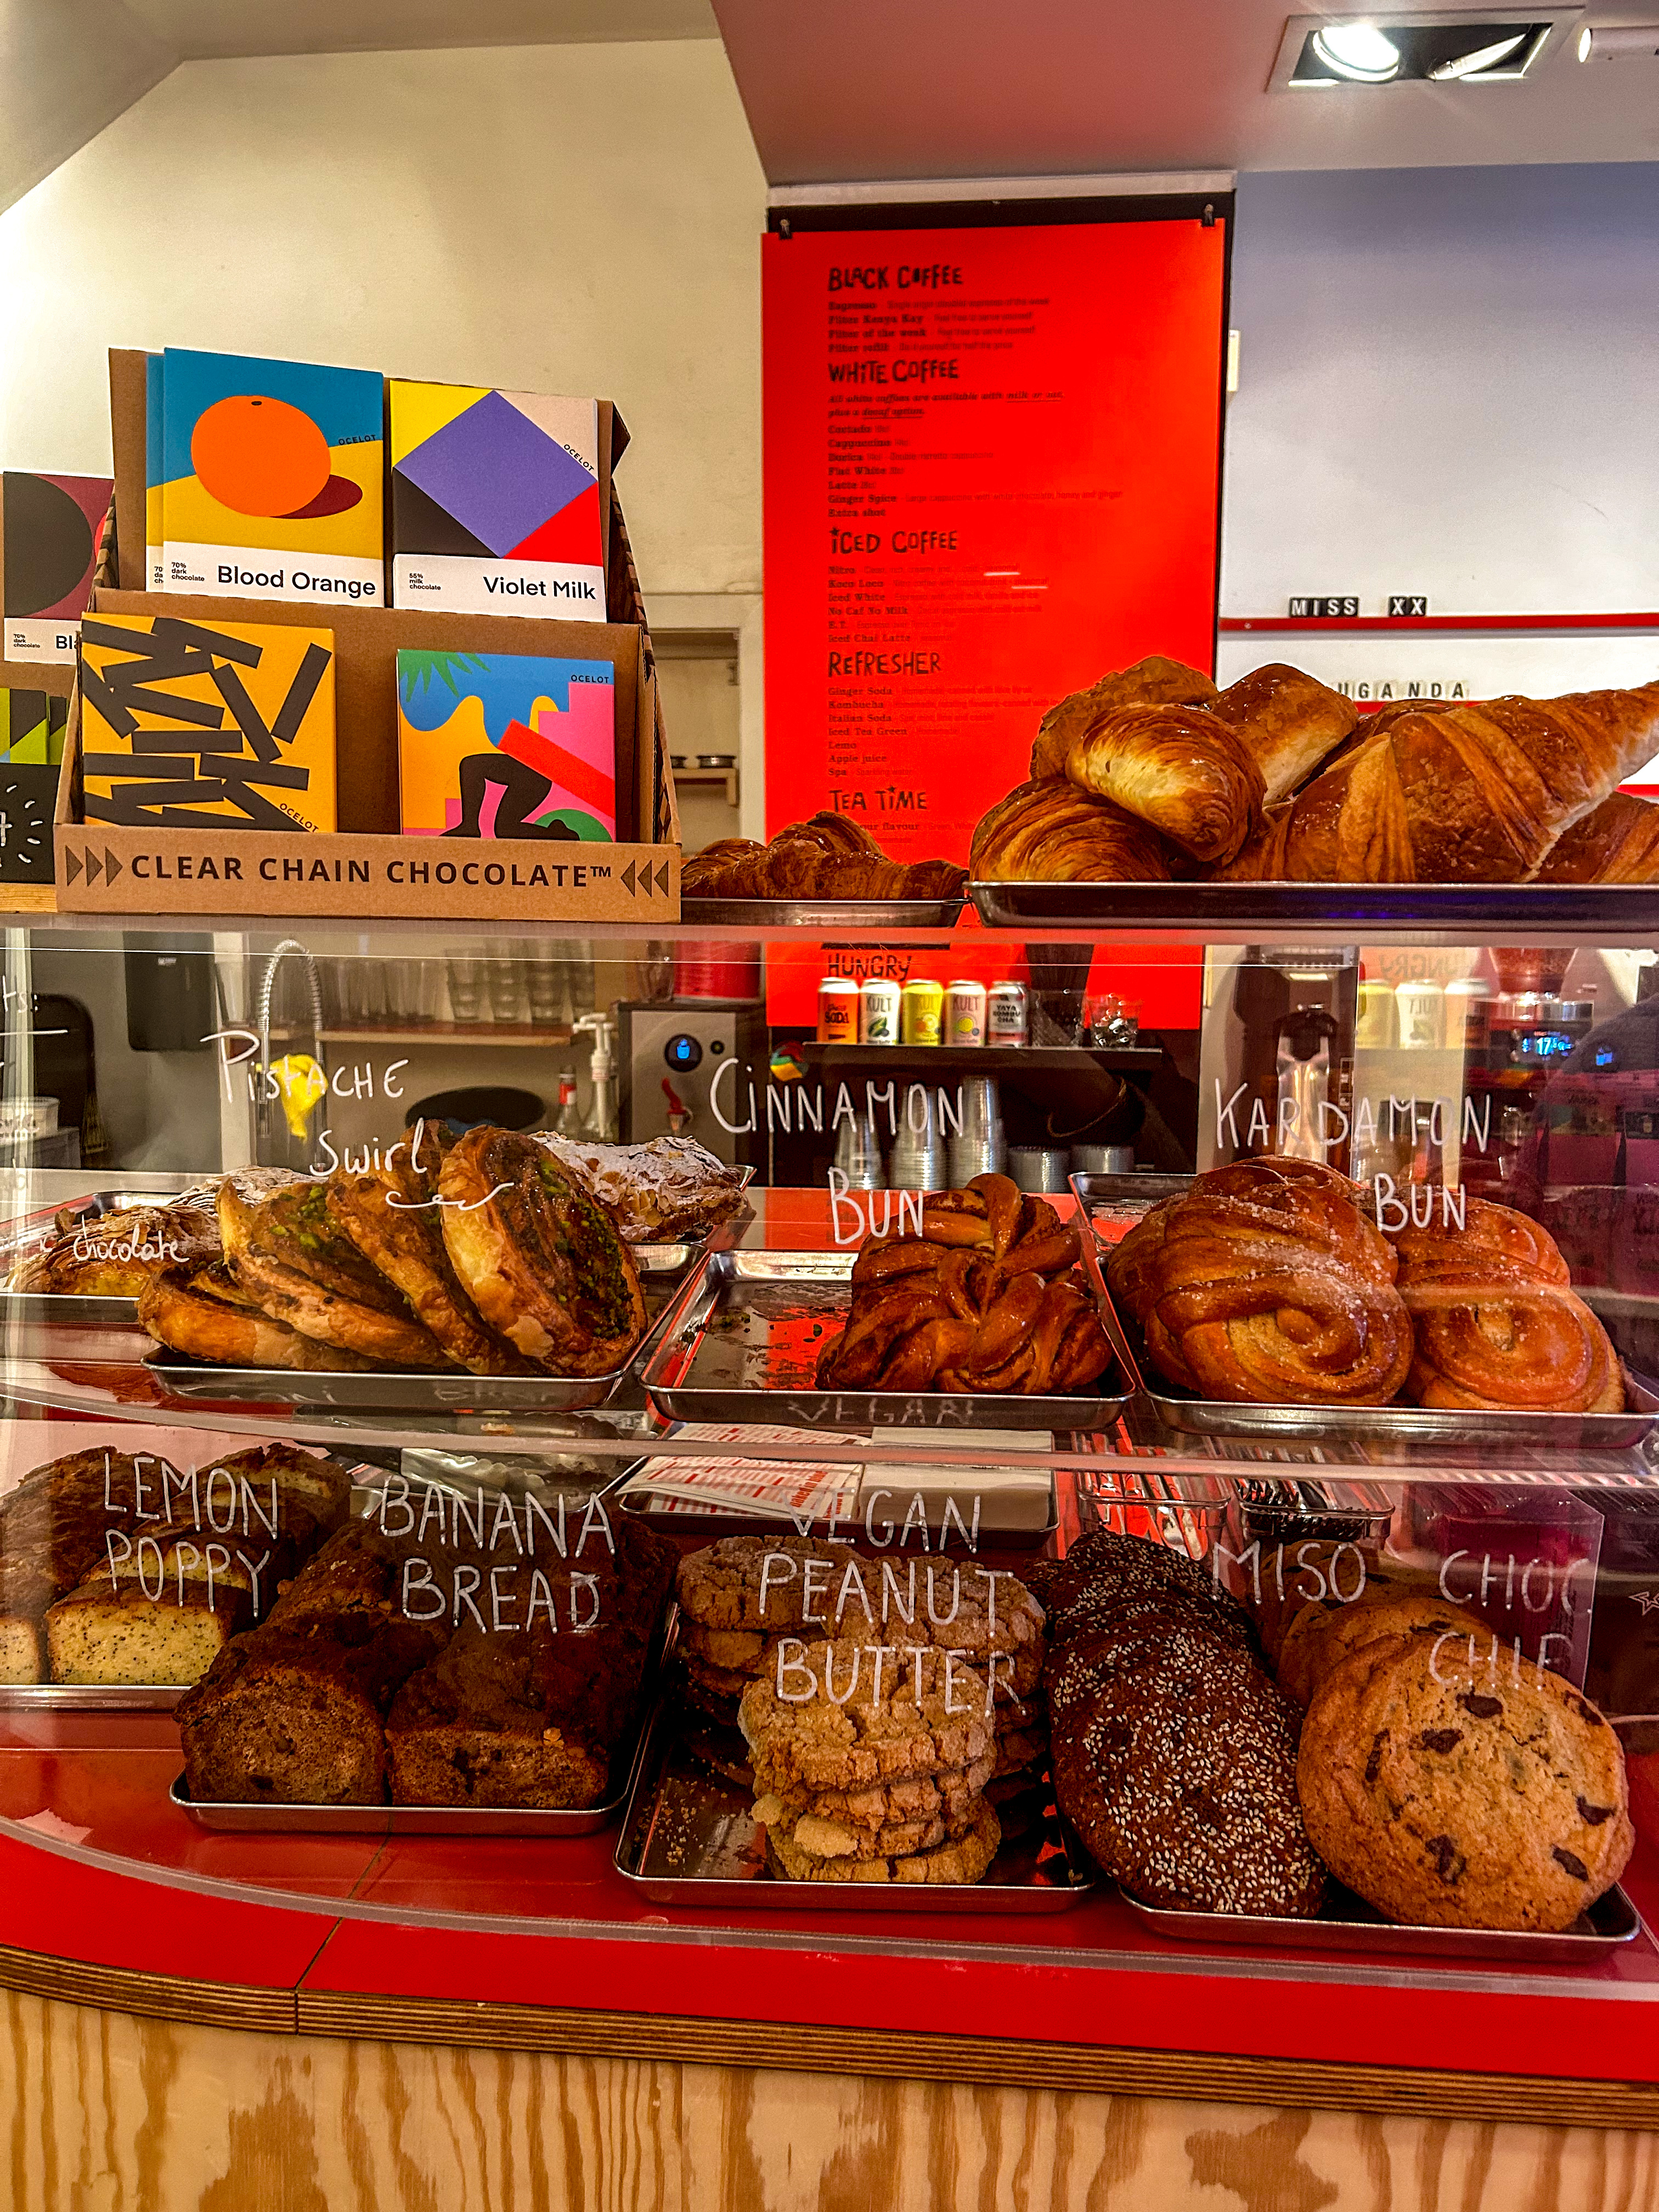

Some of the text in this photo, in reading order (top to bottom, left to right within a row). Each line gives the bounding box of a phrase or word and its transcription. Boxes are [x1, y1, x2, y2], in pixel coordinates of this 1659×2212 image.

[827, 264, 963, 291] BLACK COFFEE
[893, 358, 960, 383] COFFEE
[338, 435, 376, 445] OCELOT
[564, 444, 594, 471] OCELOT
[855, 466, 887, 476] White
[828, 481, 857, 489] Latte
[868, 493, 896, 504] Spice
[891, 529, 957, 554] COFFEE
[171, 573, 206, 582] chocolate
[218, 566, 376, 599] Blood Orange
[483, 576, 596, 600] Violet Milk
[828, 593, 850, 602] Iced
[855, 592, 885, 601] White
[1291, 598, 1425, 616] MISS XX
[828, 607, 843, 616] No
[867, 606, 882, 615] No
[885, 606, 909, 614] Milk
[828, 634, 911, 642] Iced Chai Latte
[571, 674, 610, 684] OCELOT
[1338, 682, 1464, 699] UGANDA
[828, 687, 863, 697] Ginger
[867, 686, 893, 695] Soda
[828, 700, 884, 709] Kombucha
[828, 714, 863, 722] Italian
[867, 714, 892, 722] Soda
[828, 727, 850, 736] Iced
[855, 727, 872, 735] Tea
[877, 726, 907, 735] Green
[828, 754, 887, 765] Apple juice
[828, 768, 847, 777] Spa
[828, 789, 867, 812] TEA
[279, 803, 319, 833] OCELOT
[860, 821, 919, 831] our flavour
[132, 855, 242, 881] CLEAR
[259, 857, 370, 883] CHAIN
[953, 996, 979, 1011] KULT
[1215, 1078, 1492, 1152] KARDAMON
[828, 1166, 924, 1245] BUN
[1374, 1172, 1466, 1233] BUN
[104, 1451, 278, 1540] LEMON
[379, 1474, 615, 1559] BANANA
[782, 1487, 981, 1555] VEGAN
[105, 1528, 270, 1618] POPPY
[1213, 1539, 1367, 1605] MISO
[402, 1557, 601, 1635] BREAD
[758, 1553, 1014, 1637] PEANUT
[776, 1637, 1028, 1717] BUTTER
